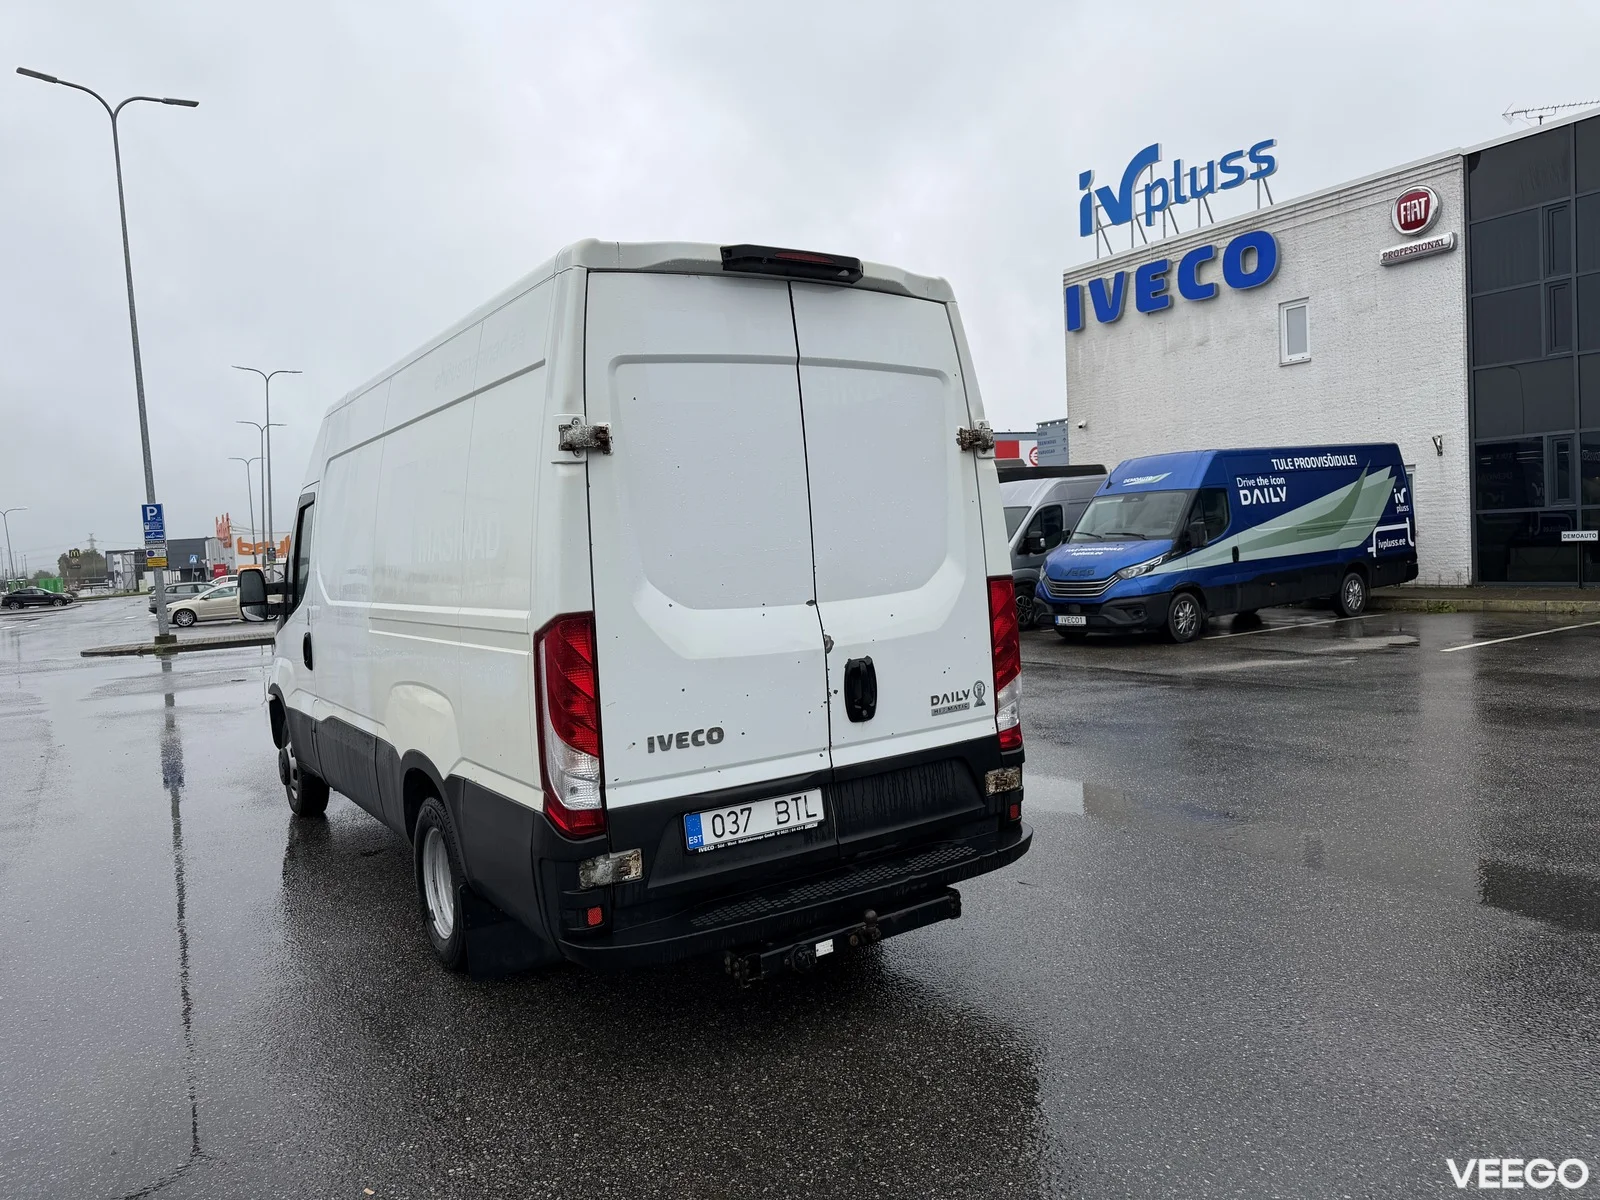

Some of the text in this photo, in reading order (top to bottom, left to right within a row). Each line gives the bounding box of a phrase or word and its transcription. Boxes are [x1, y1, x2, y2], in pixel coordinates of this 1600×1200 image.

[1400, 197, 1428, 225] FIAT
[1382, 238, 1446, 261] PROFESSIONAL
[1065, 231, 1280, 332] IVECO
[1271, 453, 1358, 470] TULE PROOVISÕIDULE!
[1236, 474, 1286, 487] Drive the icon
[1239, 487, 1286, 505] DAILY
[146, 506, 158, 521] P
[1396, 504, 1410, 514] pluss
[1378, 538, 1406, 550] ivpluss.ee
[1562, 532, 1597, 541] DEMOAUTO
[930, 688, 971, 707] DAILY
[647, 726, 725, 754] IVECO
[688, 795, 817, 845] EST 037 BTL
[698, 846, 715, 854] IVECO
